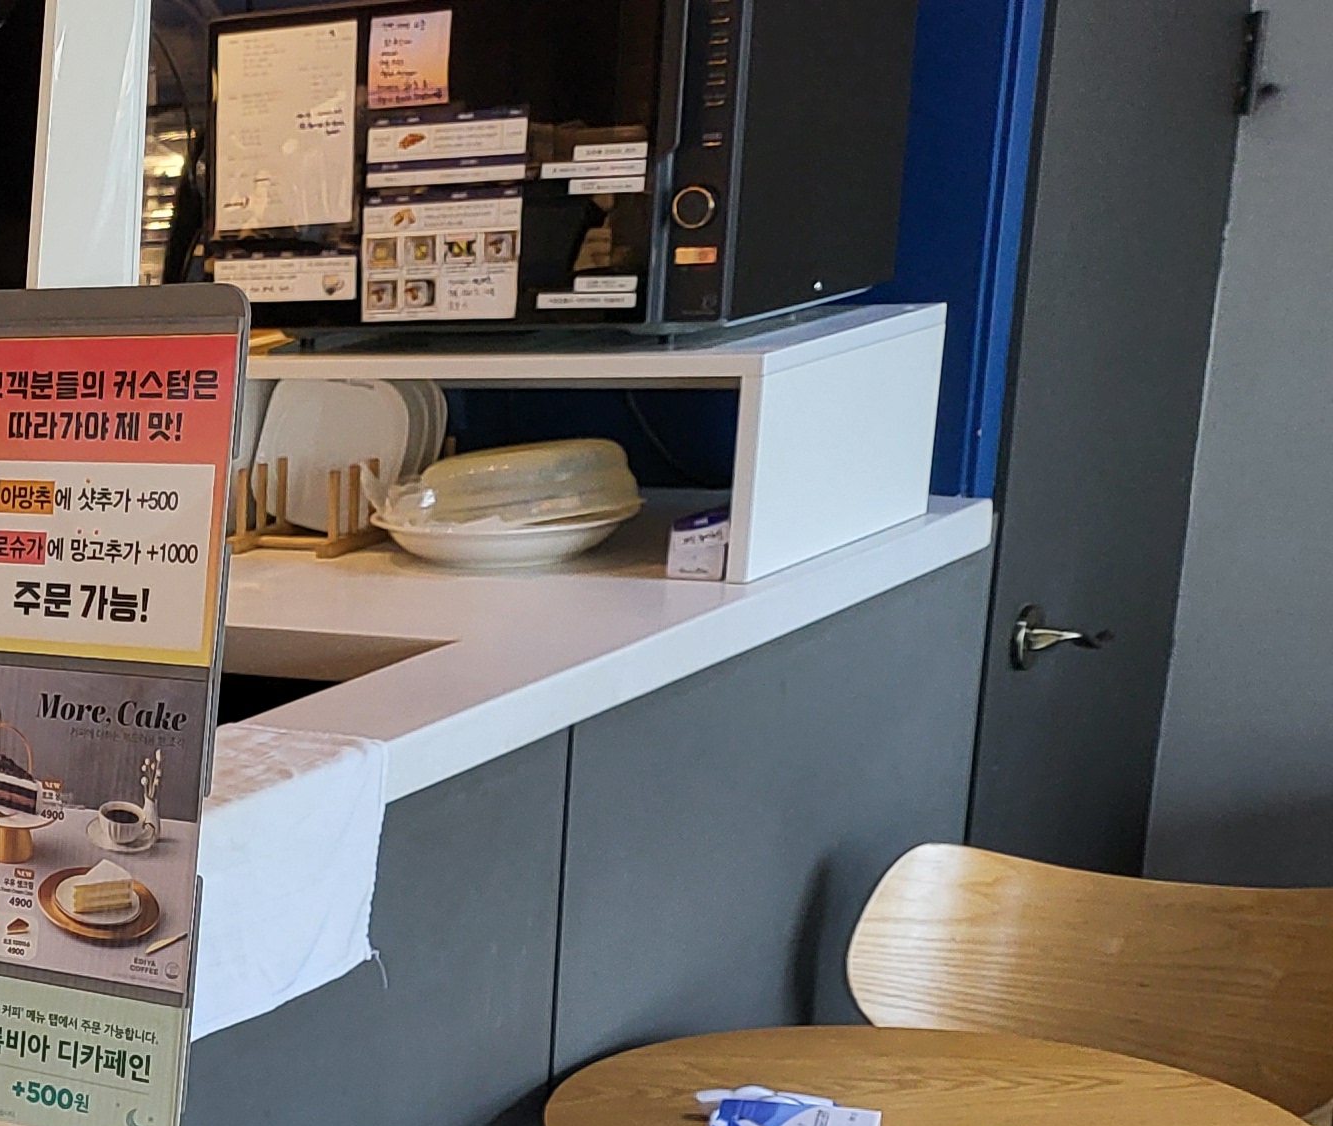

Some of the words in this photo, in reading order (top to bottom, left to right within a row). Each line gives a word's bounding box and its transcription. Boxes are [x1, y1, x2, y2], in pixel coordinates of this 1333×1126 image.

[113, 370, 218, 400] 커스텀은
[8, 411, 109, 441] 따라가야
[115, 411, 139, 441] 제
[148, 412, 183, 441] 맛!
[0, 485, 71, 510] 아망추에
[78, 487, 131, 513] 샷추가
[136, 491, 178, 510] +500
[70, 538, 141, 565] 망고추가
[147, 544, 198, 564] +1000
[14, 581, 71, 618] 주문
[81, 585, 150, 622] 가능!
[36, 693, 112, 727] More,
[118, 700, 187, 731] Cake
[41, 809, 64, 820] 4900
[9, 897, 32, 908] 4900
[7, 947, 25, 956] 4900
[134, 958, 156, 967] EDIYA
[130, 965, 158, 975] COFFEE
[26, 1009, 46, 1025] 메뉴
[48, 1013, 78, 1030] 탭에서
[81, 1019, 102, 1035] 주문
[104, 1023, 159, 1045] 가능합니다.
[58, 1039, 151, 1084] 디카페인
[12, 1080, 90, 1113] +500원
